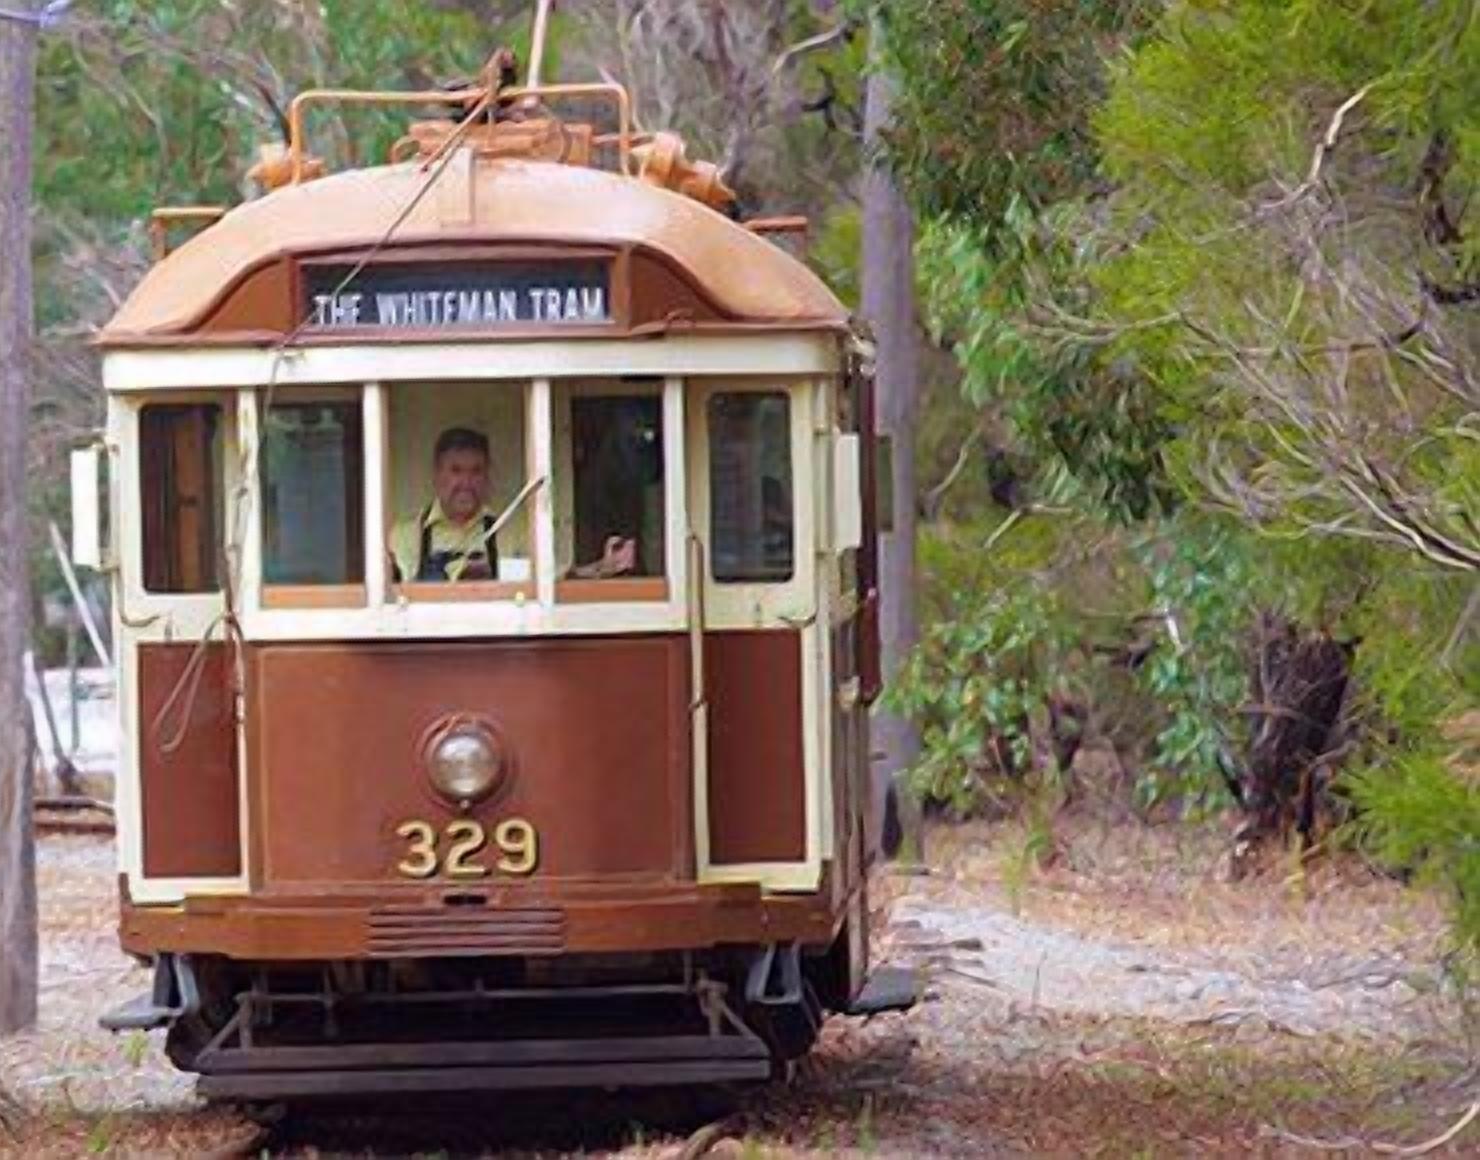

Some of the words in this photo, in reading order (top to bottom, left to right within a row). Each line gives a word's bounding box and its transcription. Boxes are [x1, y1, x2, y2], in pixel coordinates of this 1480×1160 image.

[314, 294, 362, 326] THE
[376, 290, 518, 325] WHITEMAN
[529, 287, 603, 322] TRAM
[396, 818, 537, 876] 329
